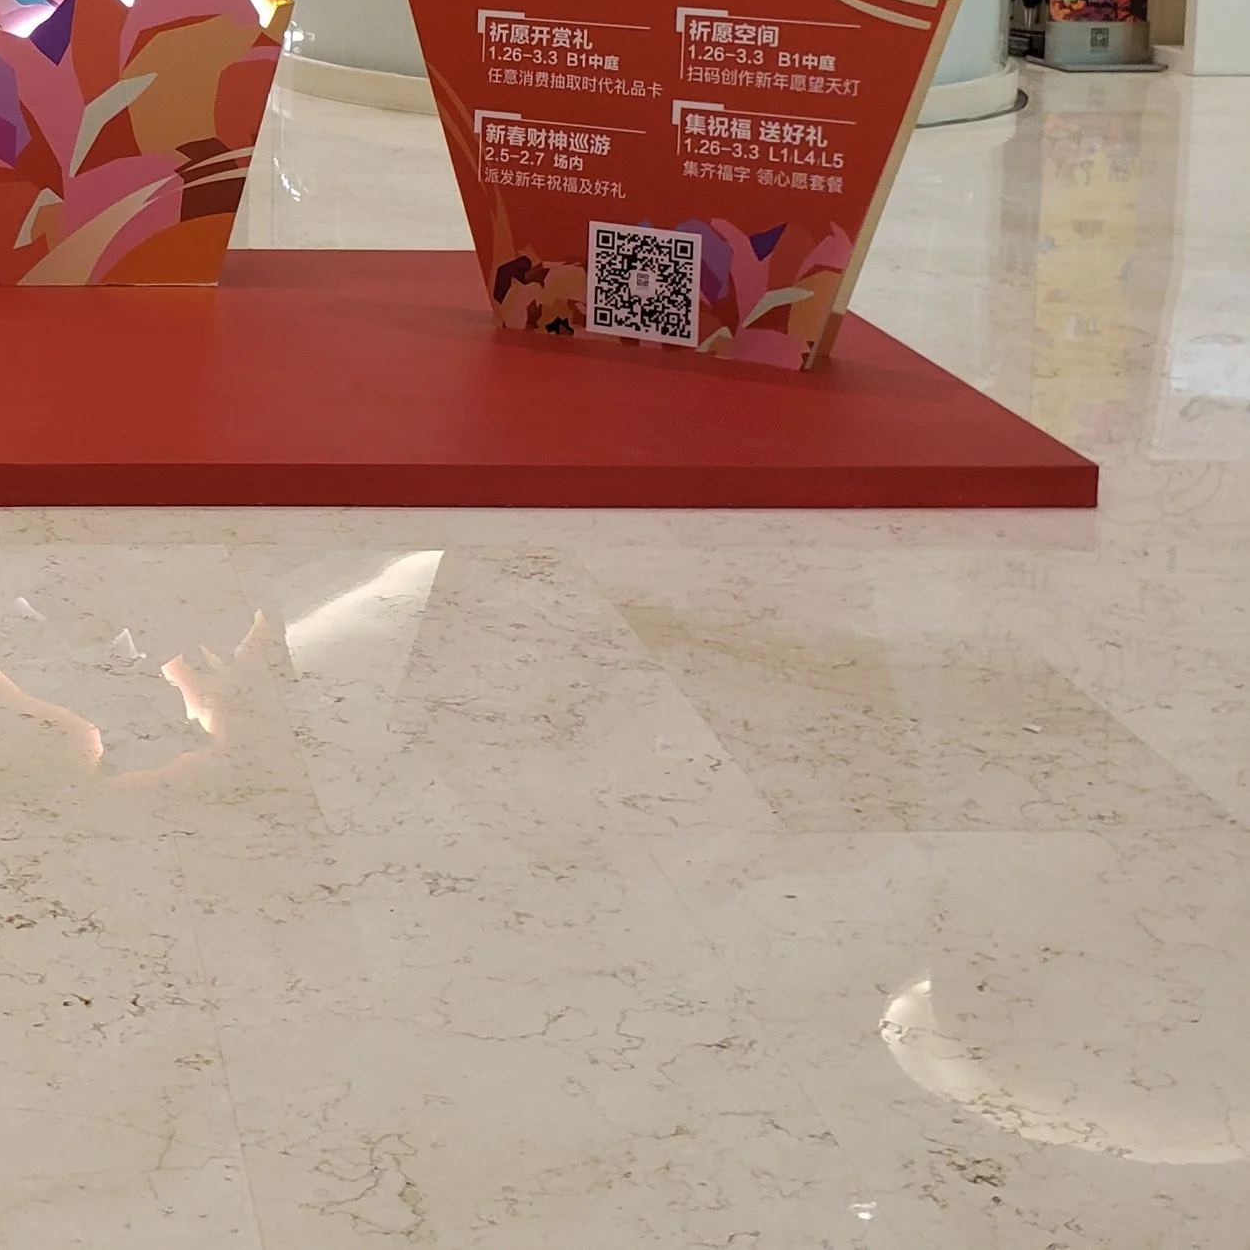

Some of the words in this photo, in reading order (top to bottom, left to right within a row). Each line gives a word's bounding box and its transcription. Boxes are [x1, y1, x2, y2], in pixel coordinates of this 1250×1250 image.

[489, 22, 593, 50] 祈愿开赏礼
[688, 19, 780, 48] 祈愿空间
[566, 52, 620, 71] B1中庭
[778, 51, 836, 72] B1中庭
[487, 67, 664, 99] 任意消费抽取时代礼品卡
[686, 65, 861, 97] 扫码创作新年愿望天灯
[485, 123, 612, 156] 新春财神巡游
[684, 113, 752, 141] 集祝福
[758, 120, 828, 148] 送好礼
[553, 153, 584, 171] 场内
[682, 160, 751, 183] 集齐福字
[756, 168, 845, 194] 领心愿套餐
[484, 167, 627, 199] 派发新年祝福及好礼
